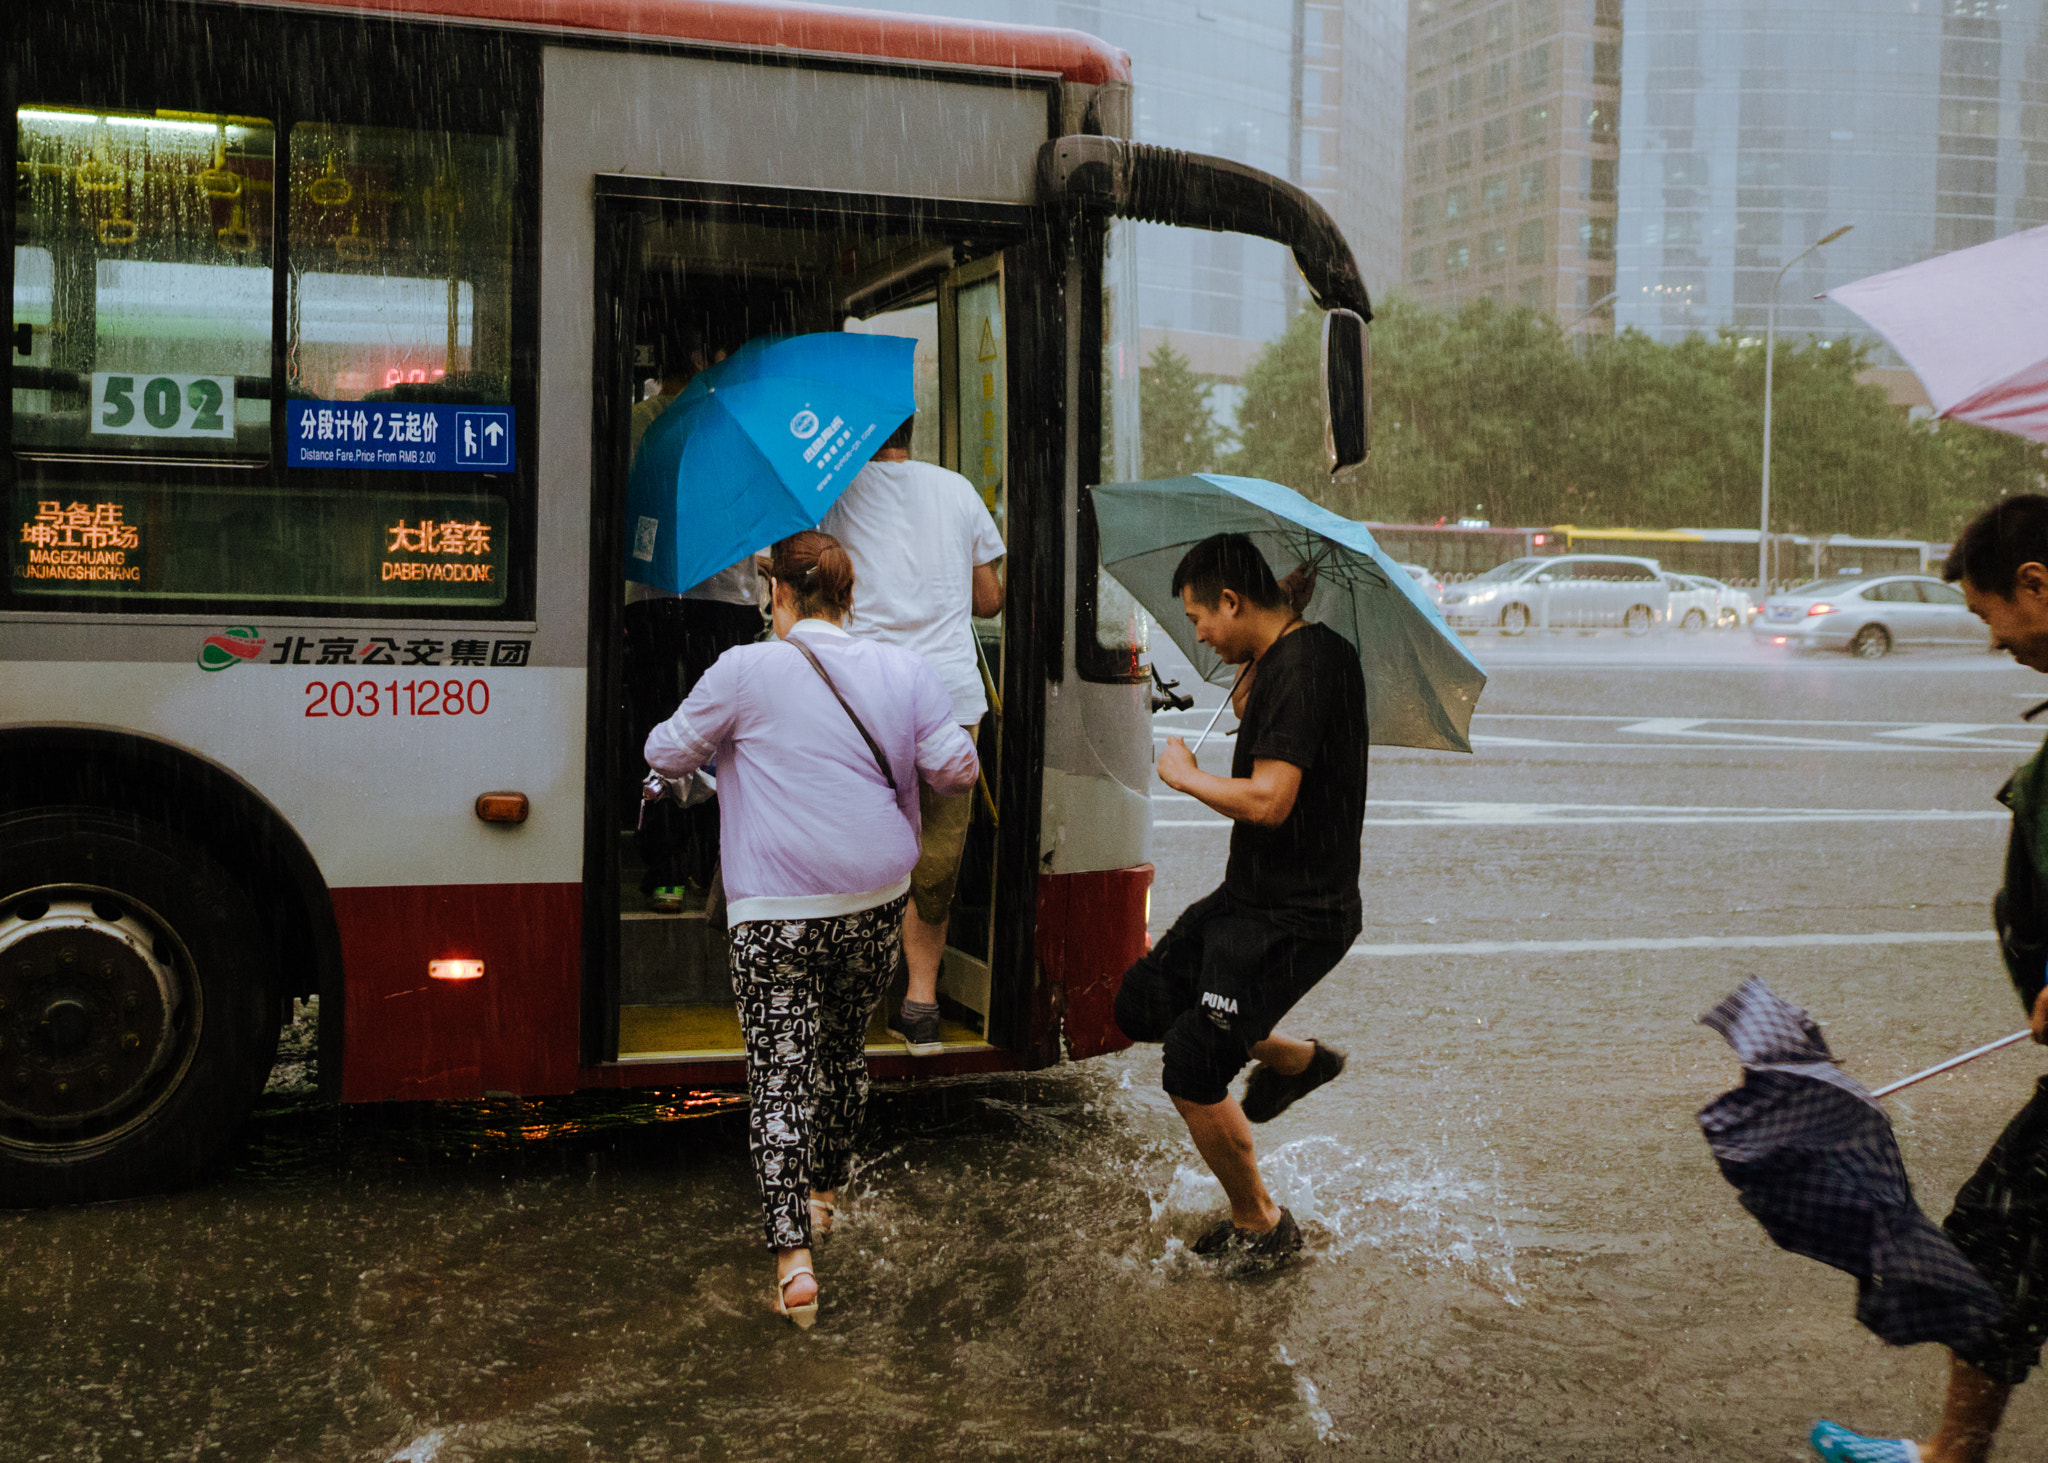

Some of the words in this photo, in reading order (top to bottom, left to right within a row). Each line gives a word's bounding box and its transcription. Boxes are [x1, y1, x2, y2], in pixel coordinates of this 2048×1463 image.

[102, 376, 224, 430] 502
[300, 447, 334, 461] Distance
[378, 450, 397, 463] From
[399, 450, 418, 463] RMB
[420, 451, 436, 464] 2.00
[35, 500, 124, 525] 马各庄
[20, 522, 139, 549] 坤江市场
[388, 519, 492, 555] 大北窑东
[29, 549, 125, 565] MAGEZHUANG
[382, 561, 495, 582] DABEIYAODONG
[269, 636, 532, 667] 北京公交集团
[304, 679, 490, 717] 20311280
[1201, 991, 1239, 1015] PUMA
